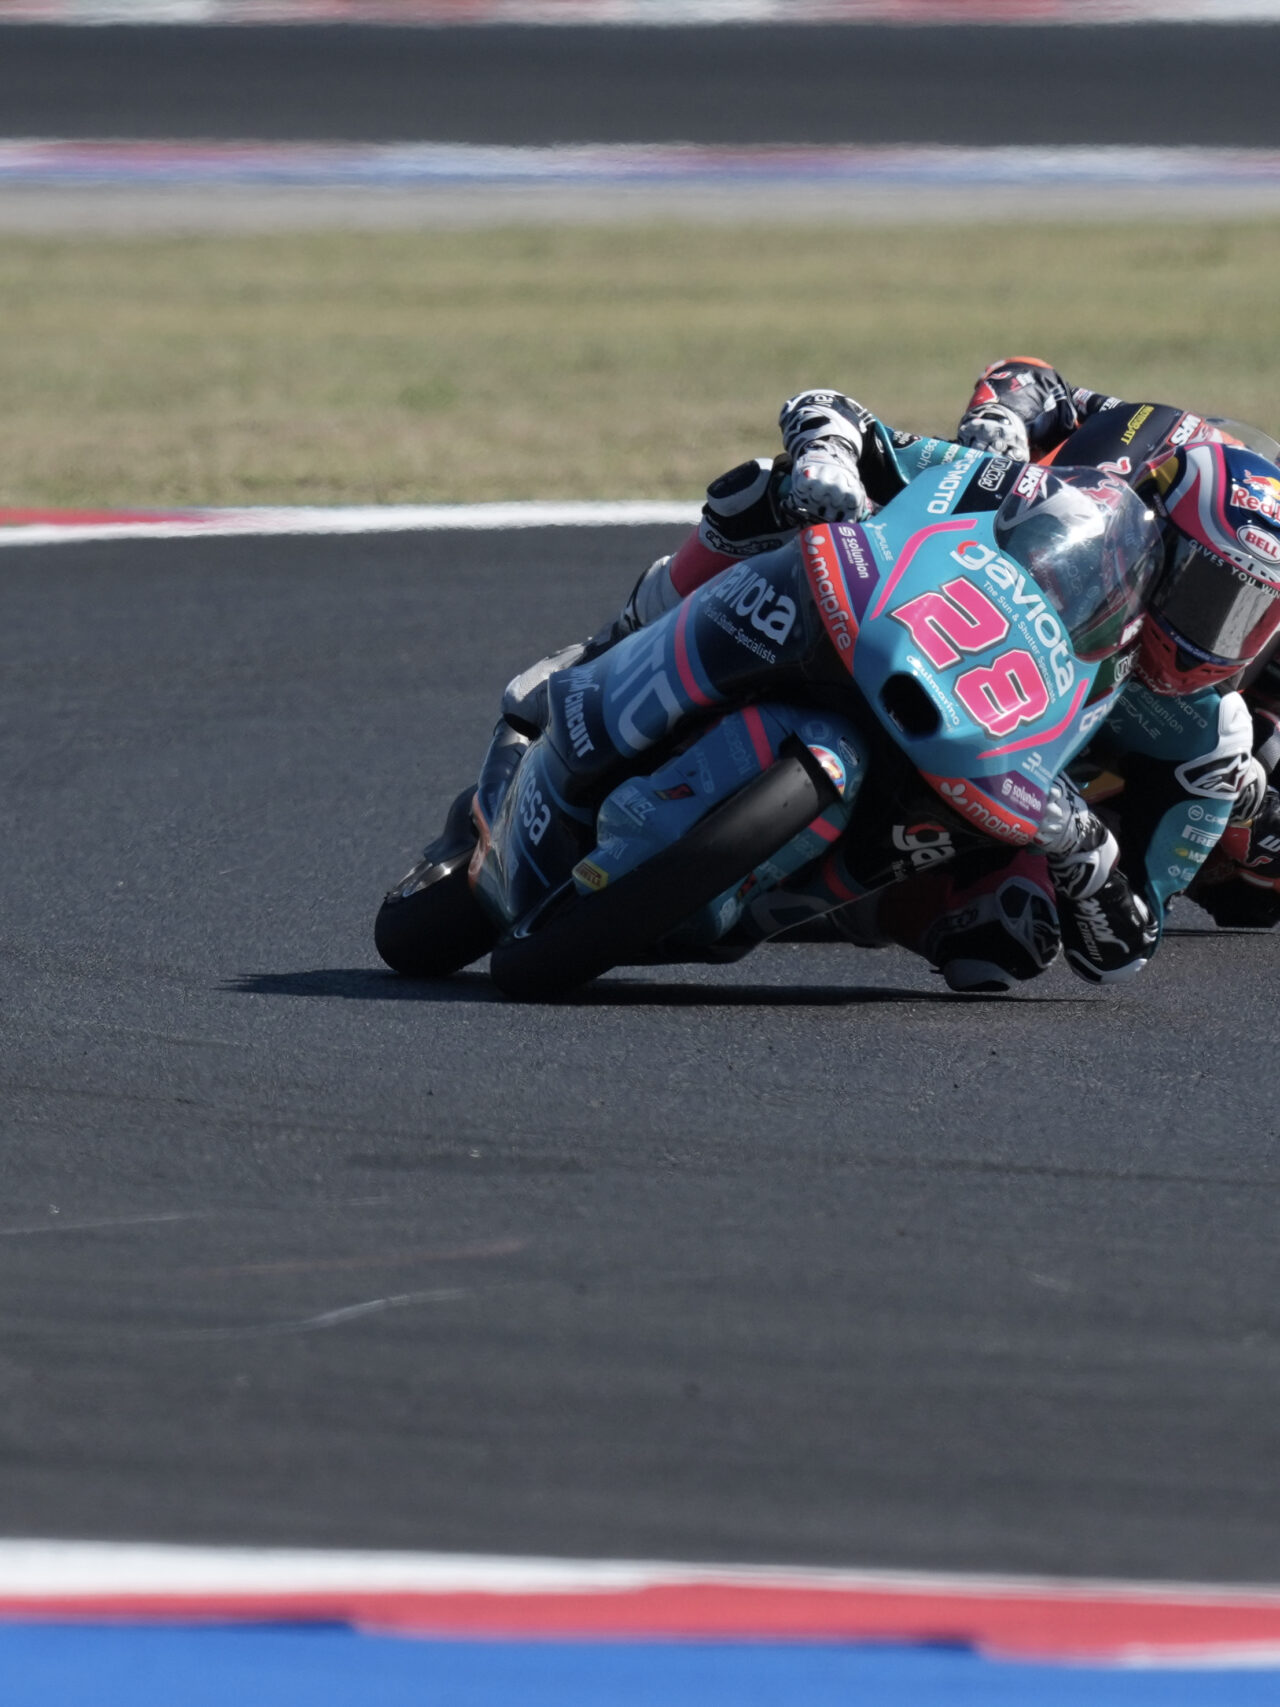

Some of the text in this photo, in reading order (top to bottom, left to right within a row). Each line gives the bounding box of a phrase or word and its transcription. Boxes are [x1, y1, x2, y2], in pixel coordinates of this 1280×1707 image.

[846, 538, 870, 579] solunion
[1188, 538, 1225, 568] GIVES
[1230, 567, 1257, 587] YOU
[1244, 531, 1279, 560] BELL
[810, 556, 852, 651] mapfre
[949, 540, 1076, 698] gaviota
[983, 580, 999, 598] The
[997, 594, 1013, 615] Sun
[1018, 620, 1042, 655] Shutter
[734, 626, 776, 665] Specialists
[888, 573, 1050, 737] 28
[564, 690, 595, 759] CIRCUIT
[1140, 690, 1185, 735] solunion
[1174, 696, 1209, 729] MOTO
[964, 800, 1031, 846] mapfre
